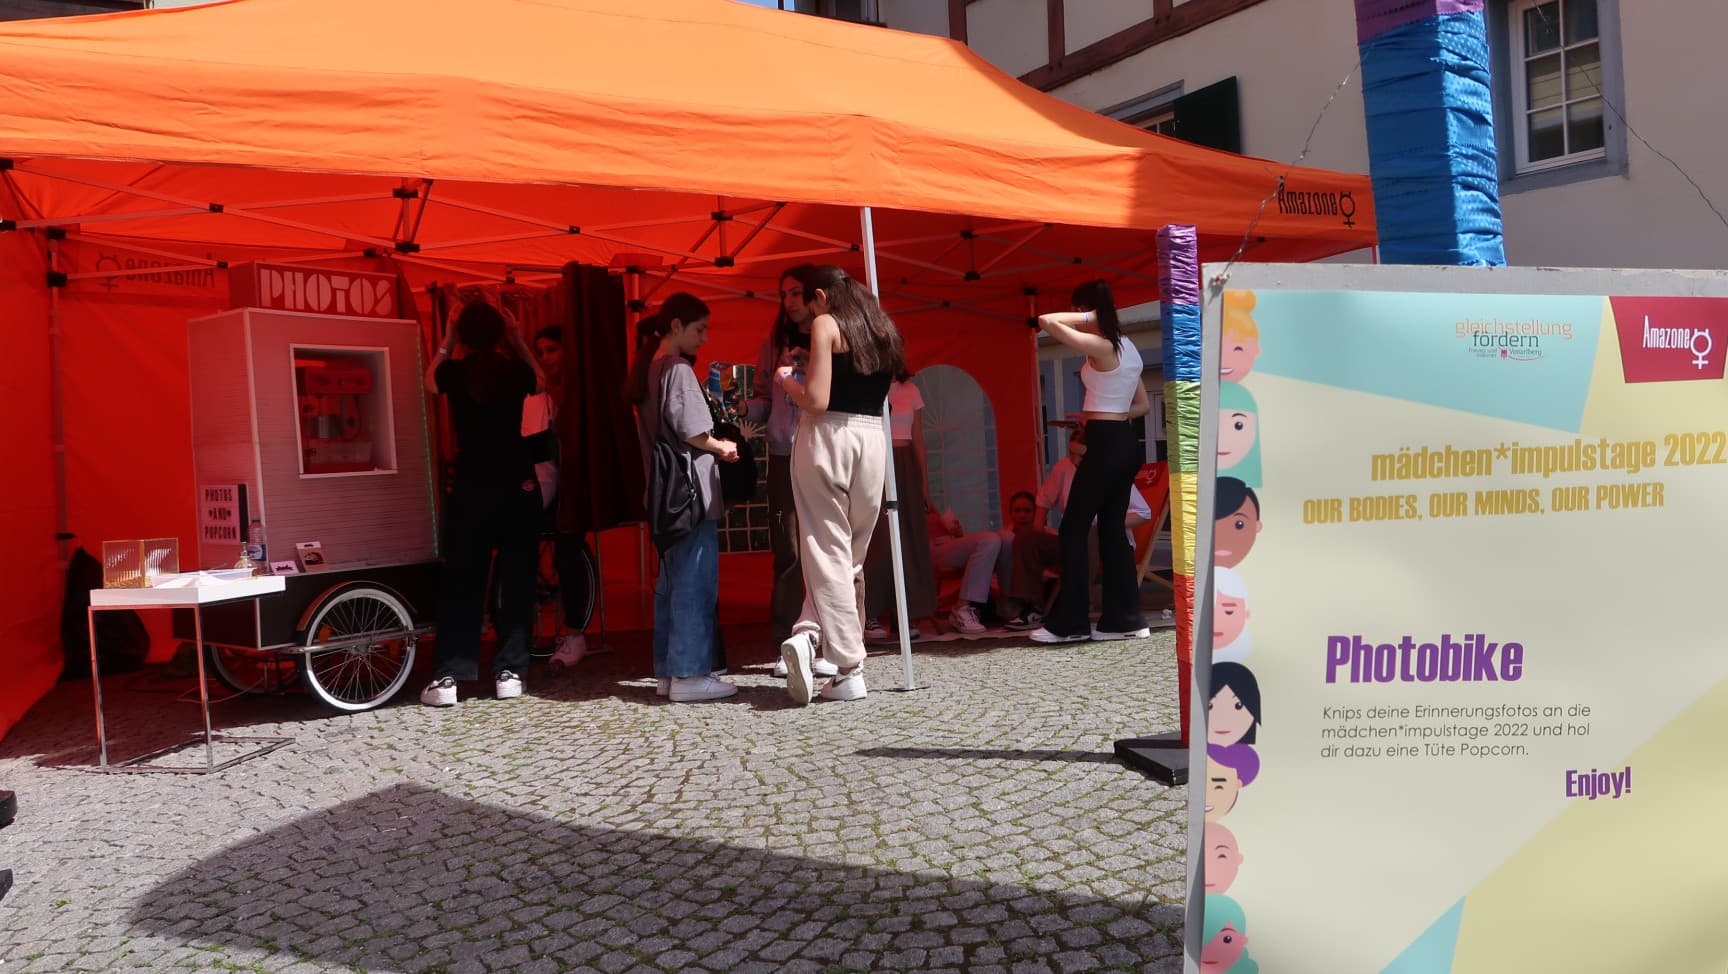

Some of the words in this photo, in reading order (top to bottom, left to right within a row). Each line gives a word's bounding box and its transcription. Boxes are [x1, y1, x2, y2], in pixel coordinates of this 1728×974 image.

[1278, 176, 1338, 216] Amazone
[260, 268, 393, 316] PHOTOS
[1455, 319, 1573, 340] gleichstellung
[1473, 331, 1540, 347] fördern
[1643, 314, 1690, 349] Amazone
[1664, 431, 1728, 467] 2022
[205, 489, 233, 501] PHOTOS
[1303, 498, 1343, 524] OUR
[1349, 494, 1423, 522] BODIES,
[1429, 492, 1468, 518] OUR
[1474, 488, 1545, 516] MINDS,
[1551, 486, 1590, 512] OUR
[1596, 482, 1665, 509] POWER
[204, 526, 237, 539] POPCORN
[1326, 634, 1524, 684] Photobike
[1323, 706, 1362, 722] Knips
[1366, 706, 1410, 719] deine
[1415, 704, 1538, 720] Erinnerungsfotos
[1542, 706, 1563, 717] an
[1567, 704, 1591, 717] die
[1494, 723, 1529, 736] 2022
[1533, 723, 1563, 736] und
[1567, 722, 1590, 736] hol
[1320, 744, 1340, 758] dir
[1343, 744, 1382, 758] dazu
[1386, 744, 1419, 757] eine
[1424, 743, 1456, 756] Tüte
[1460, 743, 1529, 758] Popcorn.
[1565, 766, 1632, 801] Enjoy!
